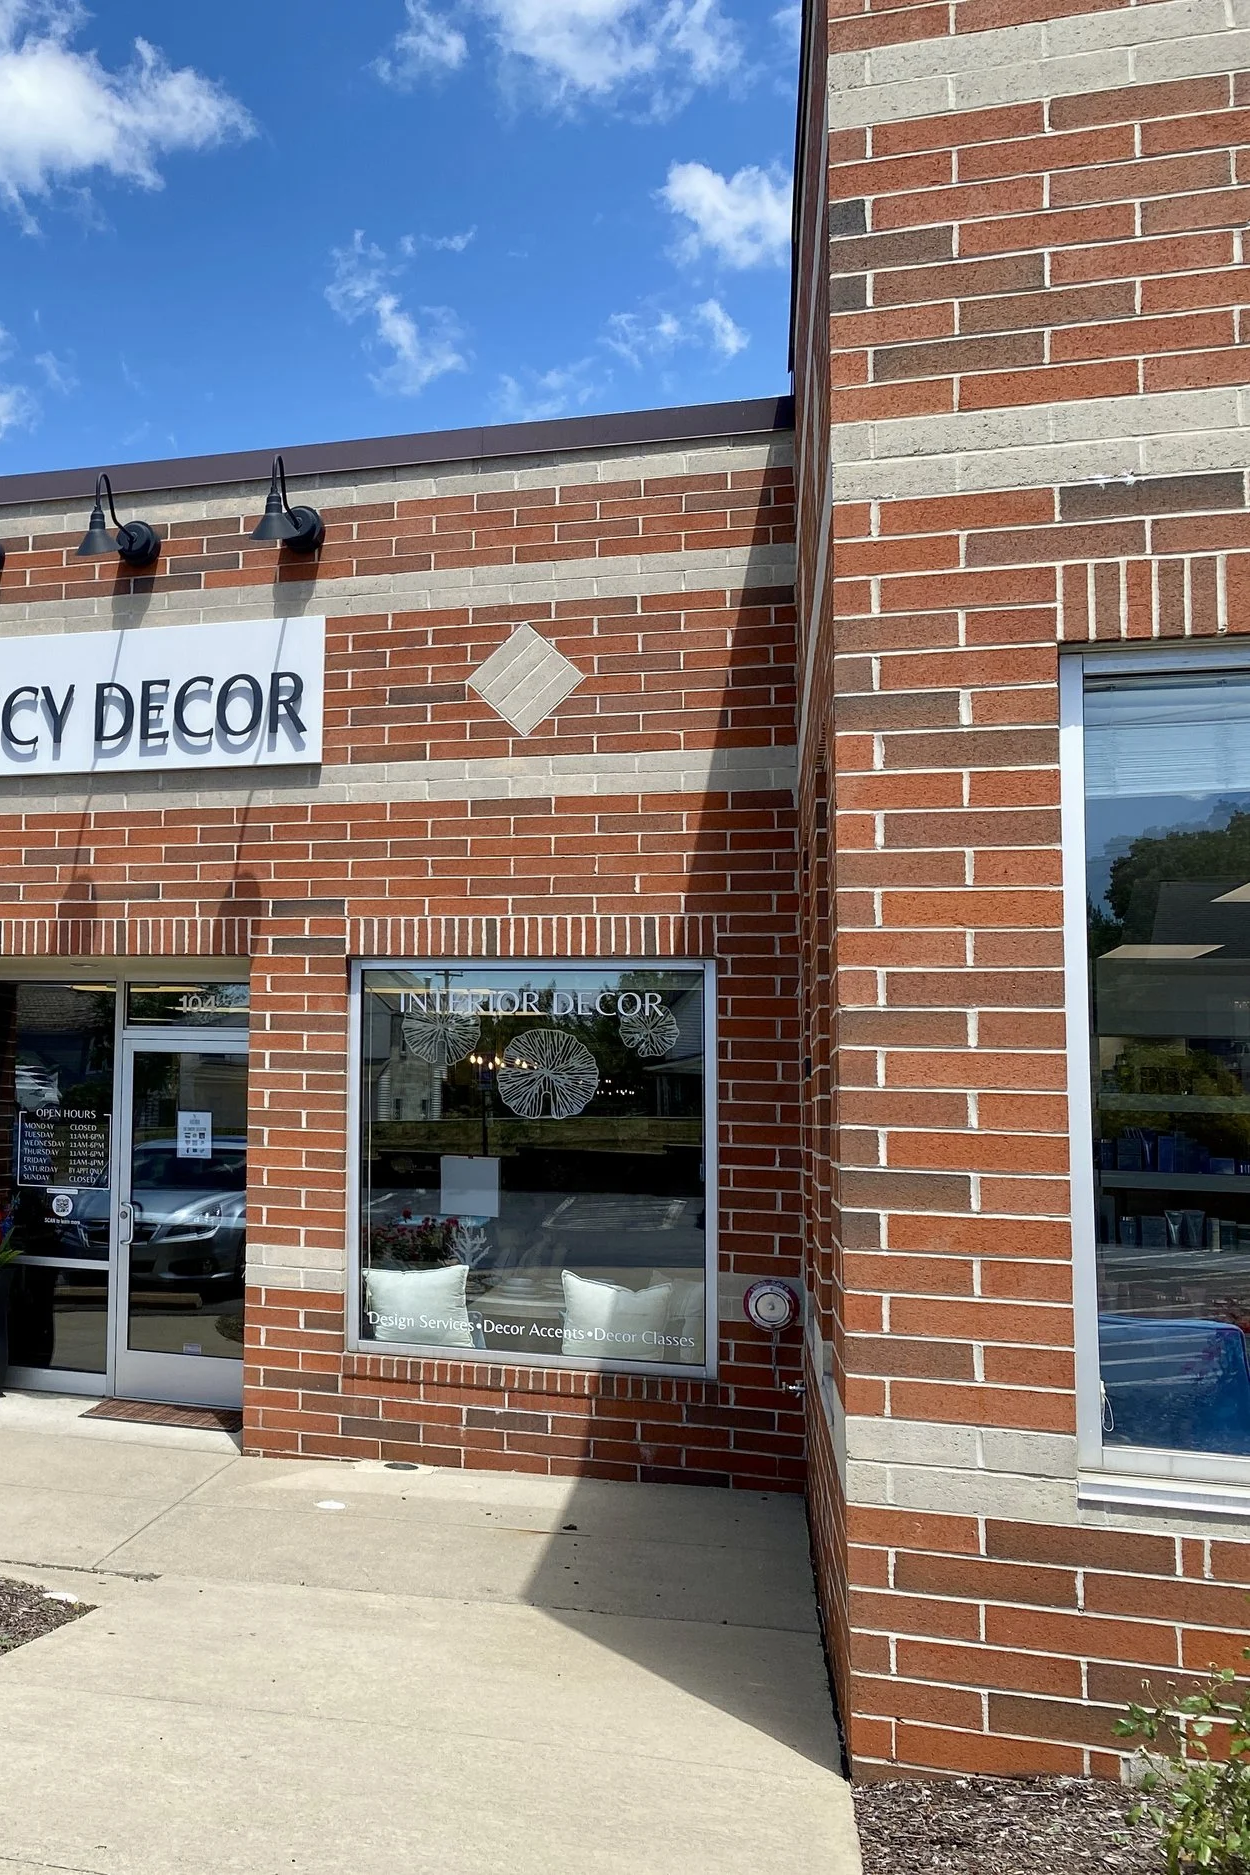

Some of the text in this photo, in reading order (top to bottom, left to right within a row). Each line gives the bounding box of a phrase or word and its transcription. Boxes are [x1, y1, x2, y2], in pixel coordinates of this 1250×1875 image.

[95, 670, 308, 742] DECOR
[178, 994, 218, 1013] 104
[400, 990, 665, 1017] INTERIOR DECOR
[36, 1108, 97, 1119] OPEN HOURS
[24, 1122, 97, 1132] MONDAY CLOSED
[23, 1139, 104, 1149] WEDNESDAY 11AM-6PM
[23, 1148, 104, 1158] THURSDAY 11AM-6PM
[23, 1156, 47, 1164] FRIDAY
[23, 1165, 58, 1173] SATURDAY
[368, 1311, 695, 1348] Design Services Decor Accents Decor Classes
